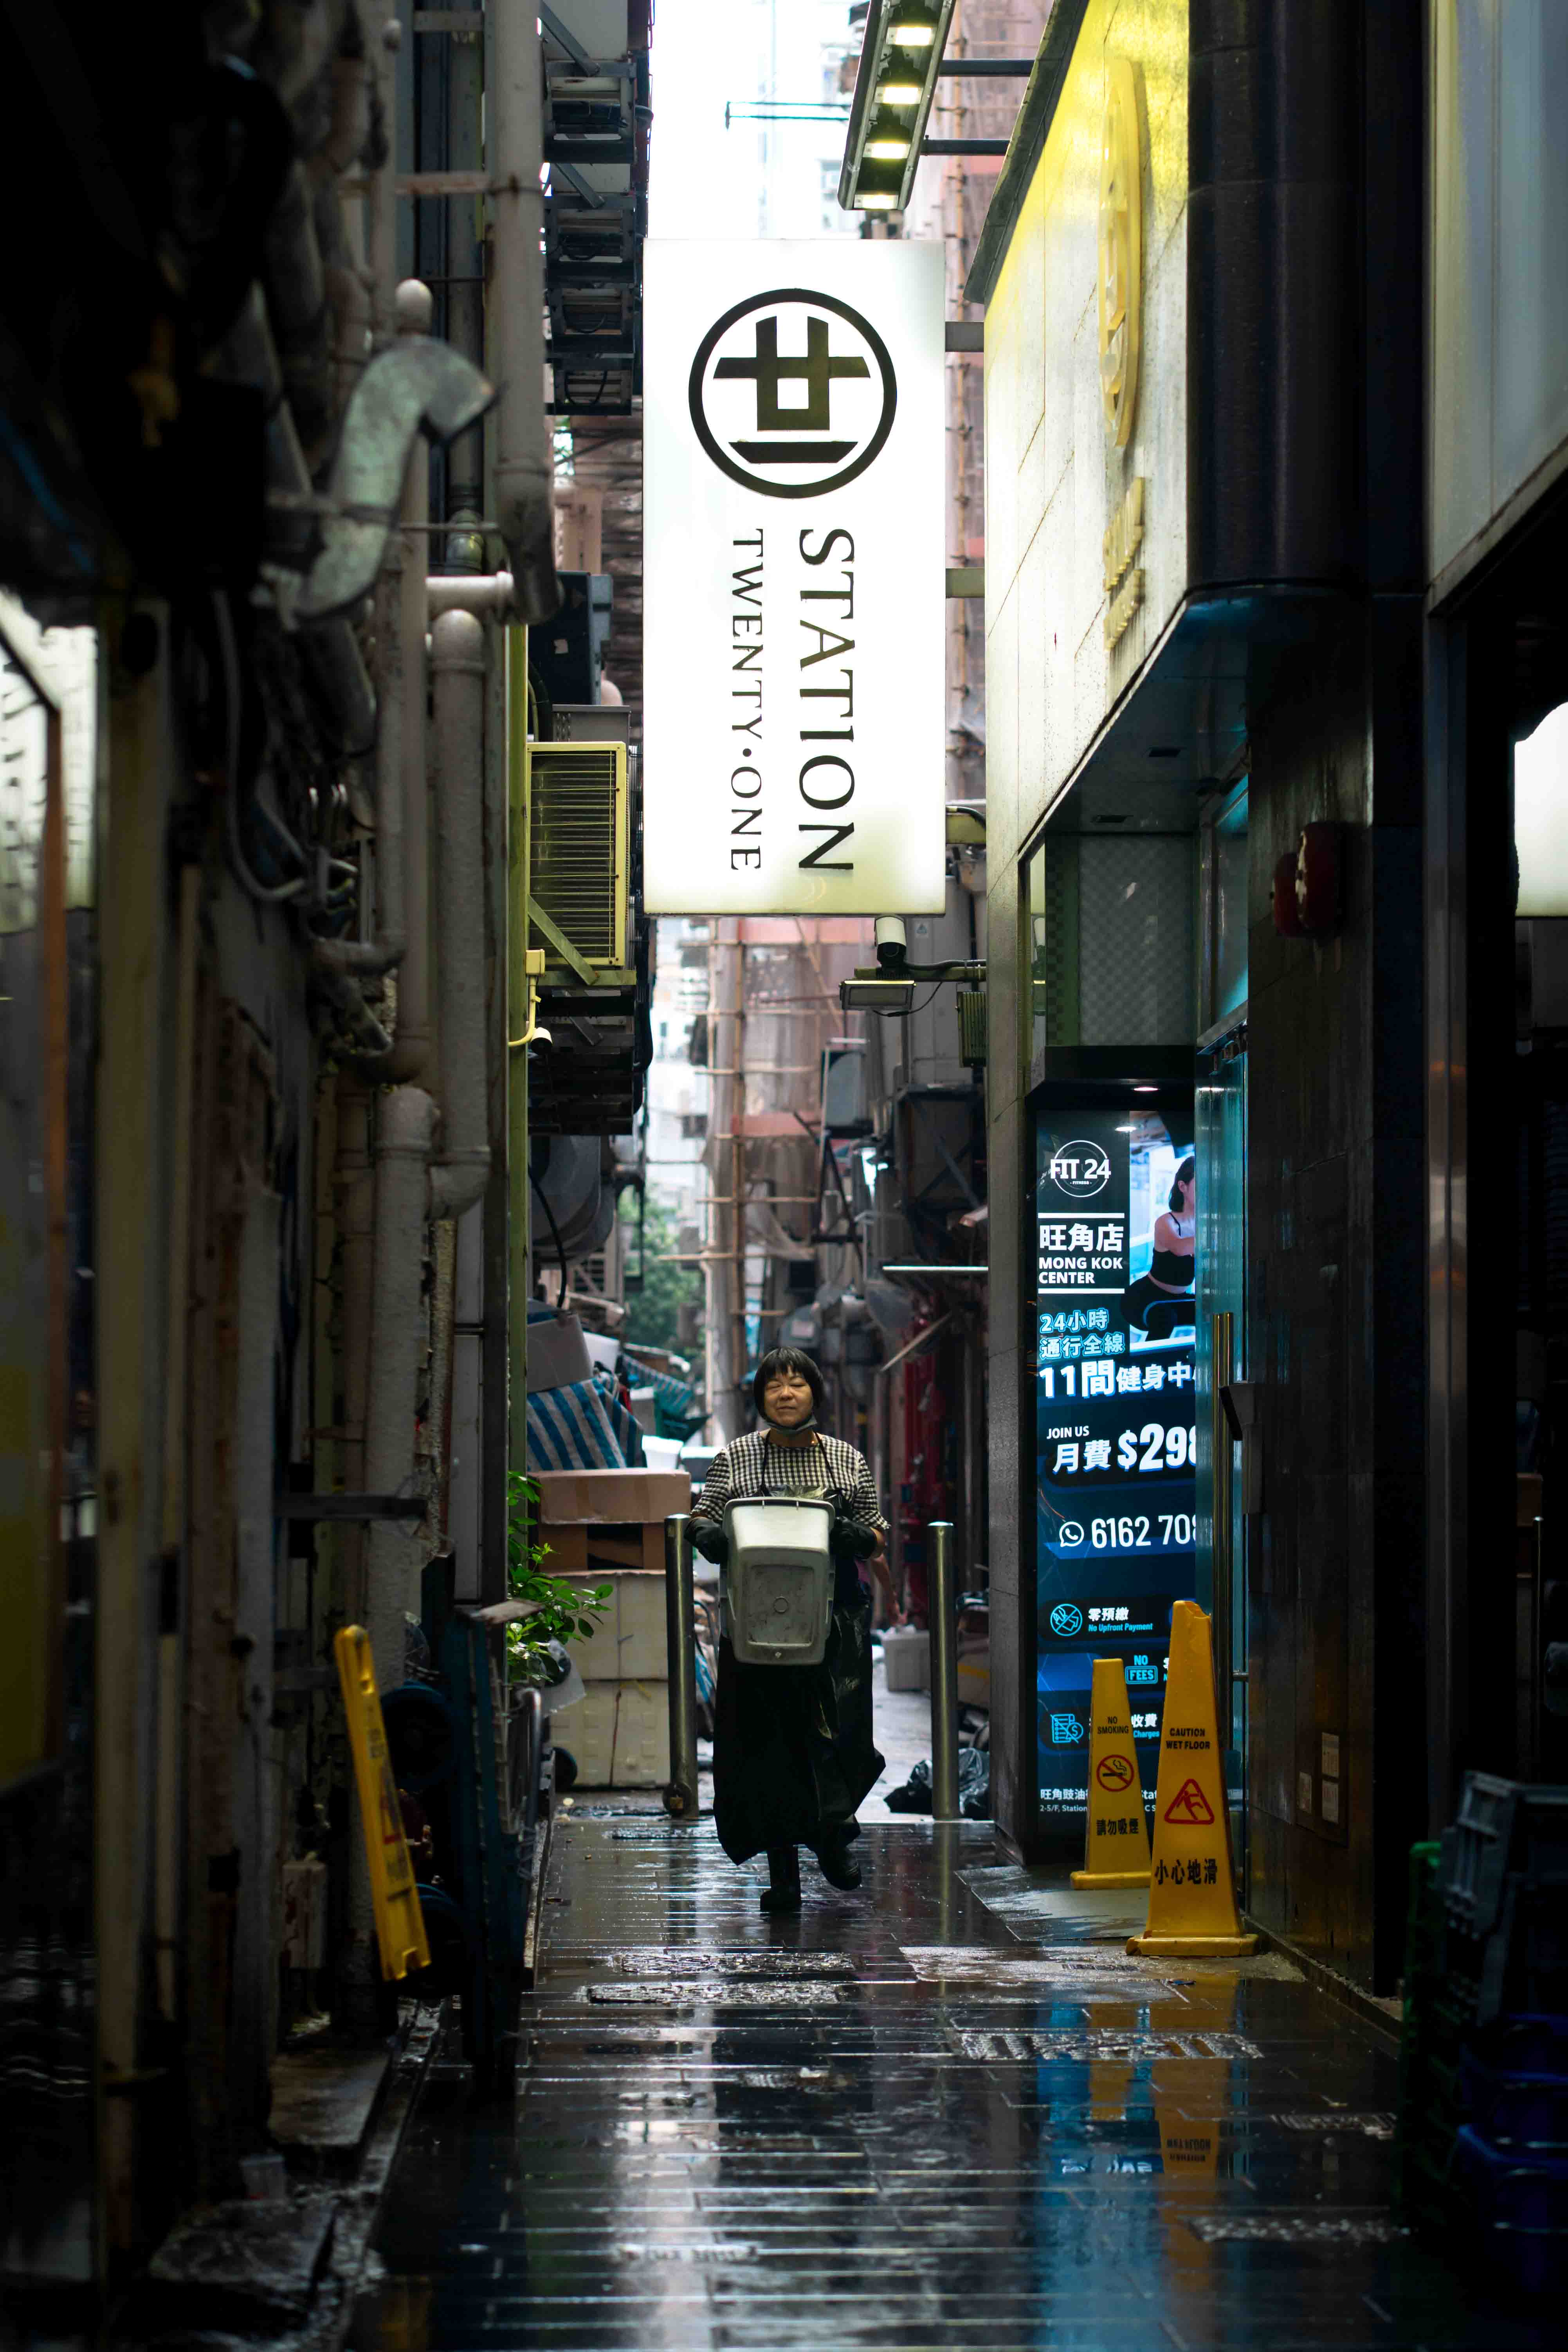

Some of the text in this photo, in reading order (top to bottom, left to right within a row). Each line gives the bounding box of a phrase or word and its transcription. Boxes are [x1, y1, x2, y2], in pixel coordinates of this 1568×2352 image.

[798, 528, 855, 871] STATION
[1051, 1159, 1111, 1179] FIT 24
[1039, 1223, 1124, 1252] 旺角店
[1039, 1257, 1123, 1269] MONG KOK
[1039, 1272, 1095, 1284] CENTER
[1040, 1308, 1109, 1333] 24小時
[1040, 1332, 1125, 1360] 通行全線
[1039, 1359, 1196, 1399] 11間健身中
[1047, 1426, 1090, 1439] JOIN US
[1052, 1439, 1112, 1474] 月費
[1091, 1514, 1196, 1548] 6162 70
[1099, 1623, 1123, 1633] Upfront
[1125, 1623, 1153, 1633] Payment
[1134, 1655, 1148, 1665] NO
[1130, 1669, 1154, 1680] FEES
[1107, 1716, 1118, 1724] NO
[1097, 1725, 1129, 1735] SMOKING
[1133, 1730, 1160, 1739] Charges
[1170, 1728, 1206, 1737] CAUTION
[1166, 1740, 1211, 1750] WET FLOOR
[1154, 1858, 1217, 1885] 小心地滑
